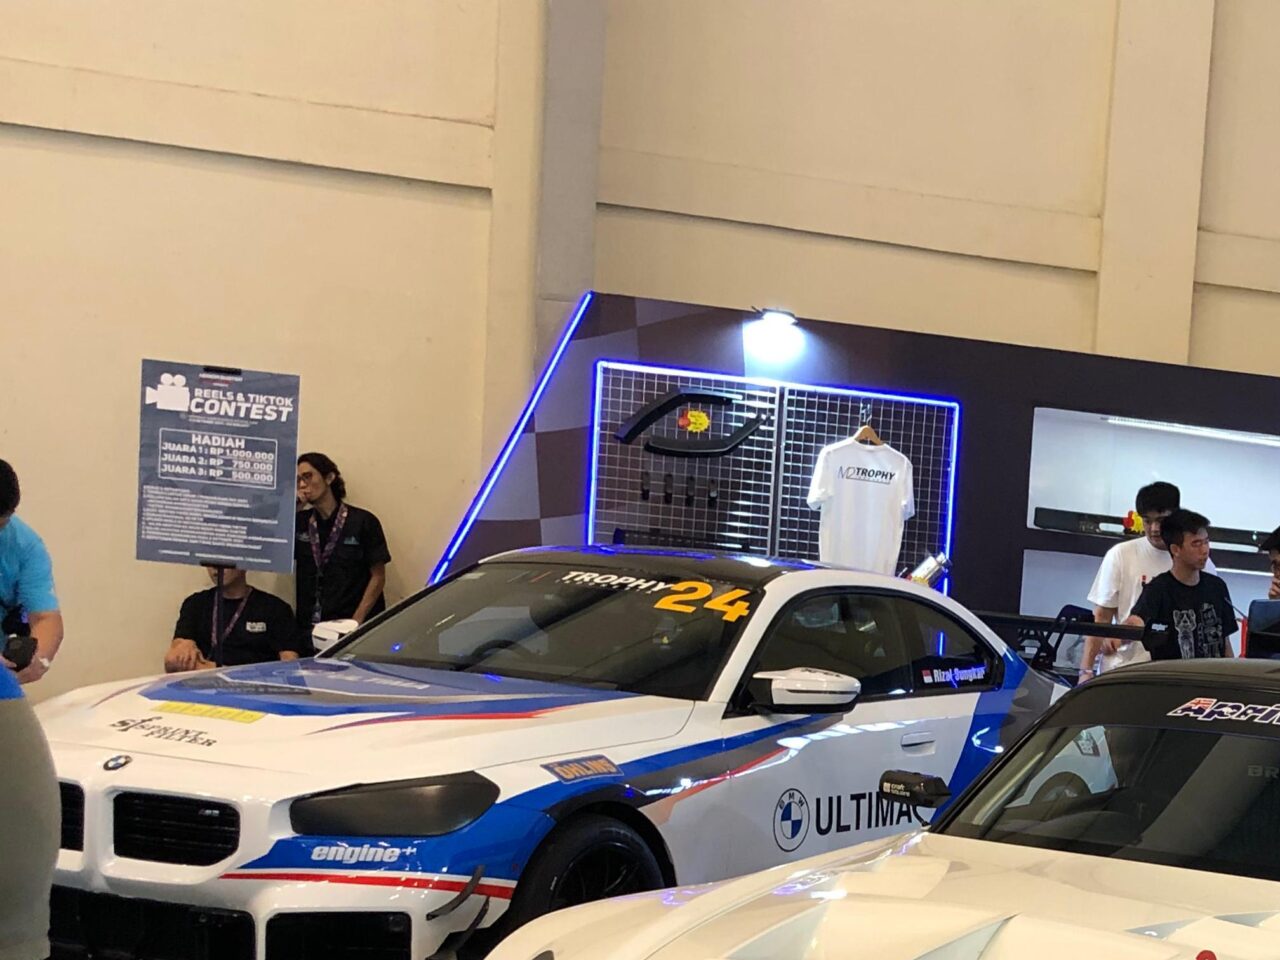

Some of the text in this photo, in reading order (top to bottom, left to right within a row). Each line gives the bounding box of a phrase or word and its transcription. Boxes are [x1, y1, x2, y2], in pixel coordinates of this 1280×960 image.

[194, 388, 294, 407] REELS & TIKTOK
[190, 398, 293, 422] CONTEST
[162, 442, 197, 454] JUARA
[210, 447, 225, 456] RP
[191, 433, 246, 449] HADIAH
[162, 453, 197, 465] JUARA
[209, 458, 224, 467] RP
[161, 464, 197, 475] JUARA
[209, 468, 224, 478] RP
[562, 570, 672, 594] TROPHY
[653, 580, 750, 622] 24
[933, 667, 952, 682] Rizal
